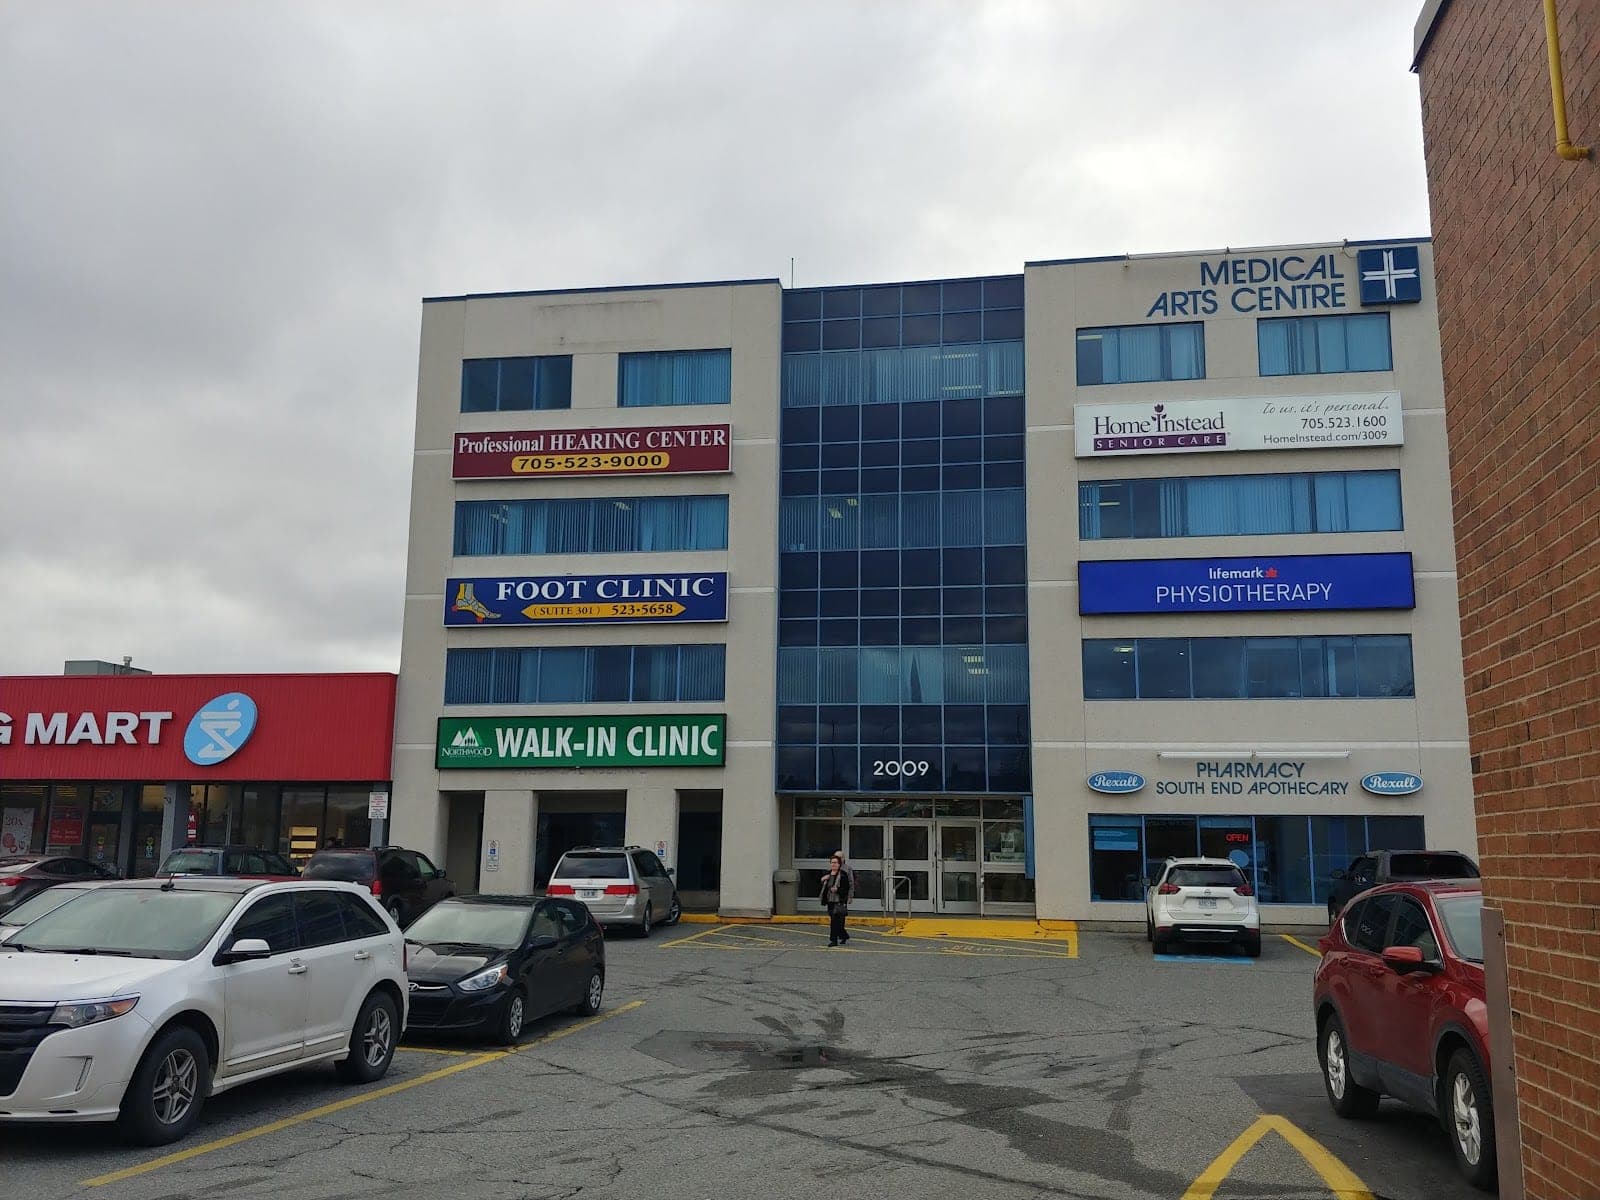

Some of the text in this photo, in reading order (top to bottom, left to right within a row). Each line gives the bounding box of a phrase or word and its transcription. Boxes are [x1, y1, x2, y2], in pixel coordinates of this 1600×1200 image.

[1200, 254, 1345, 286] MEDICAL
[1146, 283, 1346, 318] ARTS CENTRE
[1263, 402, 1276, 414] To
[1093, 411, 1225, 435] Home Instead
[1300, 415, 1388, 429] 705.523.1600
[458, 429, 727, 454] Professional HEARING CENTER
[1096, 435, 1223, 449] SENIOR CARE
[1263, 430, 1388, 444] HomeInstead.com/3009
[1208, 566, 1264, 580] lifemark
[495, 577, 715, 601] FOOT CLINIC
[1156, 582, 1333, 604] PHYSIOTHERAPY
[24, 711, 173, 745] MART
[495, 724, 718, 758] WALK-IN CLINIC
[872, 760, 930, 777] 2009
[1196, 762, 1305, 778] PHARMACY
[1094, 774, 1140, 788] Rexall
[1156, 781, 1349, 795] SOUTH END APOTHECARY
[1369, 775, 1416, 789] Rexall
[1225, 833, 1249, 842] OPEN
